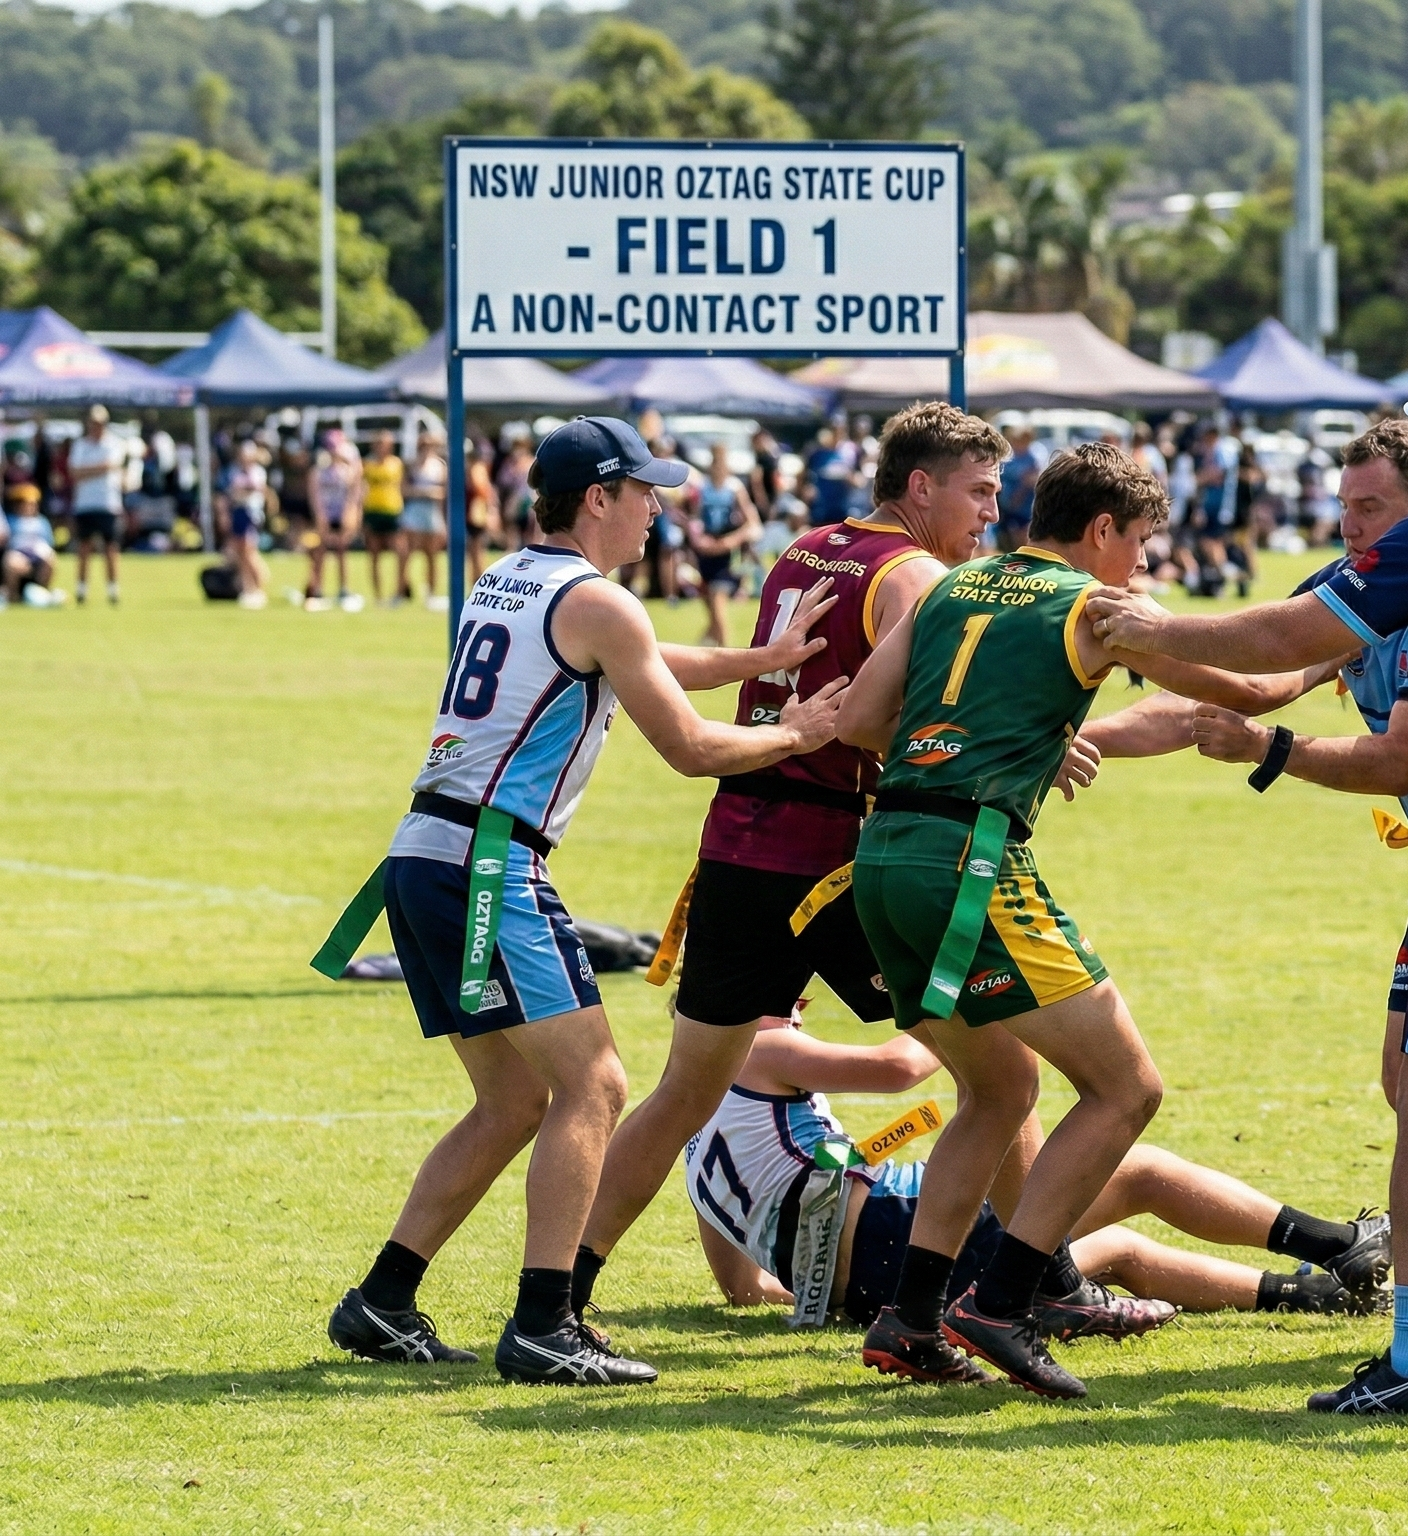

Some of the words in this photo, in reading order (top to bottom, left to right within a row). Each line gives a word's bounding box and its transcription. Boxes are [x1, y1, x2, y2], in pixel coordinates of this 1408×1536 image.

[469, 164, 538, 198] NSW
[550, 165, 664, 199] JUNIOR
[676, 166, 772, 200] OZTAG
[784, 166, 873, 200] STATE
[885, 168, 945, 201] CUP
[567, 246, 590, 259] -
[617, 217, 785, 274] FIELD
[812, 218, 836, 275] 1
[471, 294, 496, 333] A
[513, 294, 799, 334] NON-CONTACT
[816, 294, 945, 333] SPORT
[478, 573, 502, 590] SW
[497, 577, 543, 598] JUNIOR
[949, 586, 1000, 603] STATE
[1000, 592, 1036, 607] CUP
[953, 570, 995, 586] NSW
[992, 575, 1058, 594] JUNIOR
[471, 592, 502, 609] STATE
[501, 597, 525, 613] CUP
[440, 619, 512, 720] 18
[941, 613, 994, 706] 1
[696, 1129, 753, 1245] 17
